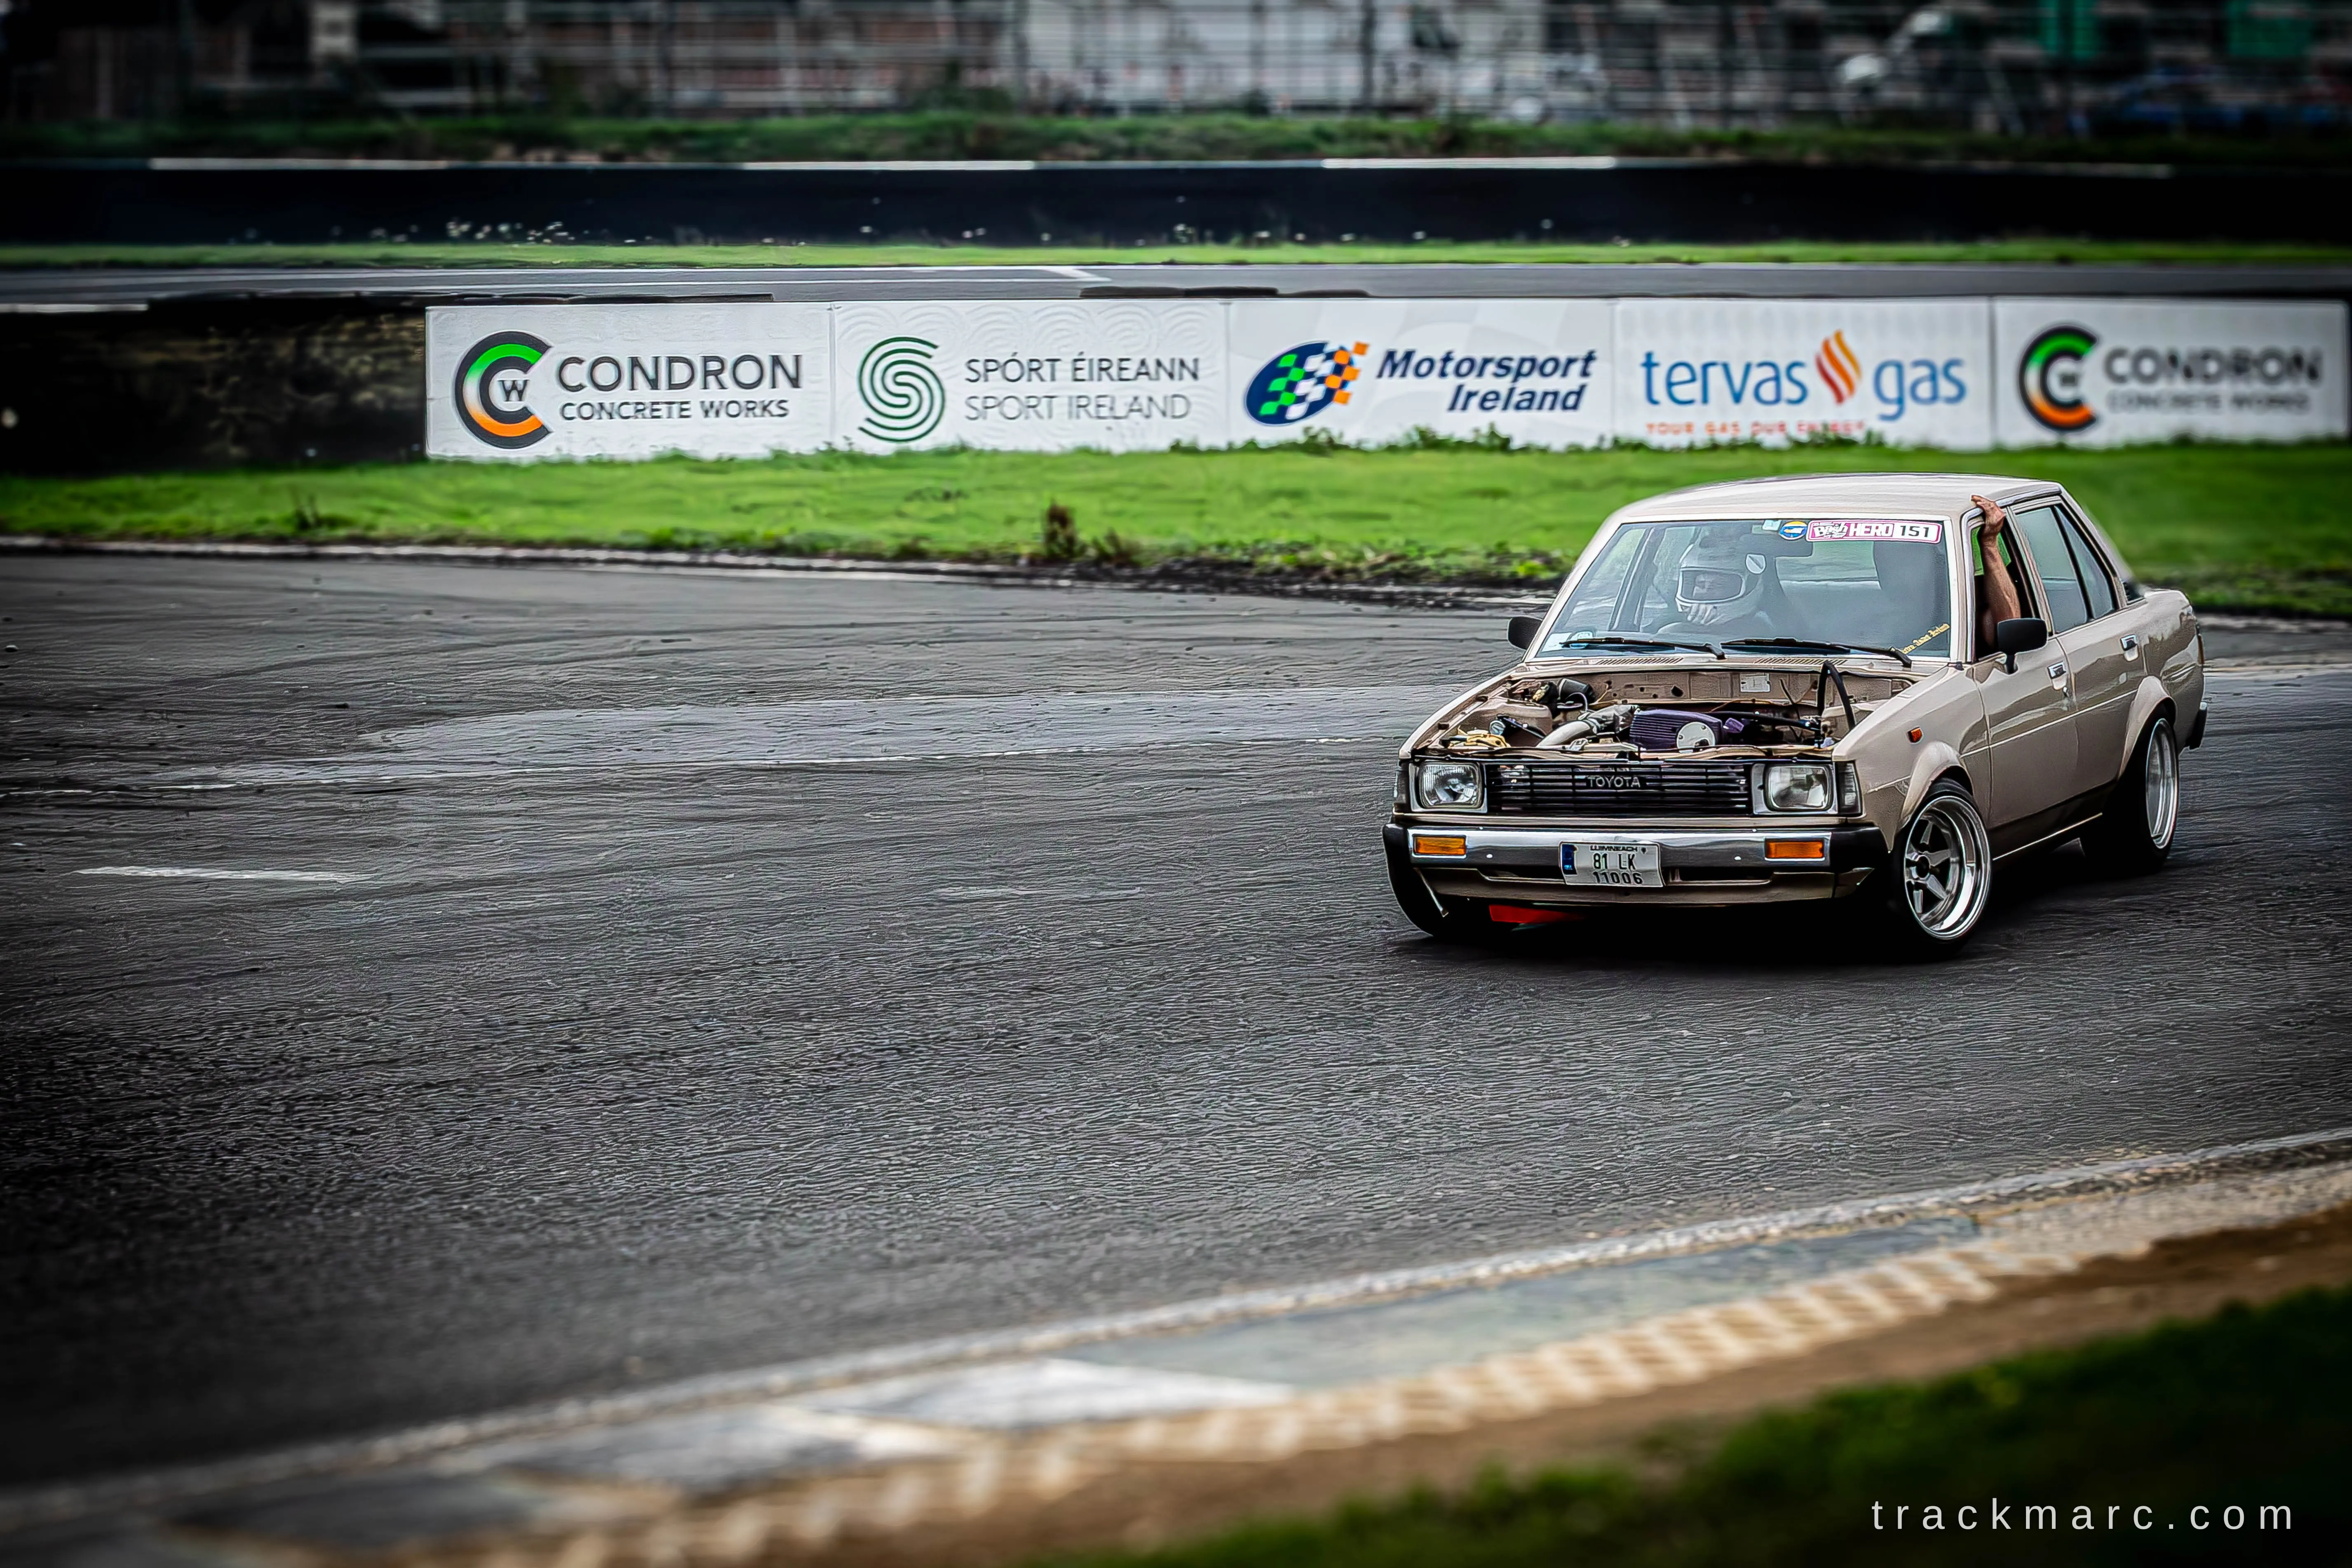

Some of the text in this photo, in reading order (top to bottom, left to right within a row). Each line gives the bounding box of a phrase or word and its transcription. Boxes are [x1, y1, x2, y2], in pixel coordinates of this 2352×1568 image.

[556, 354, 803, 392] CONDRON
[965, 351, 1199, 383] SPÓRT ÉIREANN
[1376, 350, 1597, 383] Motorsport
[1447, 383, 1587, 412] Ireland
[1641, 350, 1968, 422] tervas gas
[560, 399, 789, 420] CONCRETE WORKS
[965, 394, 1191, 420] SPORT IRELAND
[1646, 421, 1694, 435] YOUR
[1704, 421, 1740, 435] GAS
[1848, 523, 1894, 537] HERO
[1900, 525, 1930, 538] 151
[1587, 775, 1641, 788] TOYOTA
[1593, 853, 1636, 870] 81 LK
[1592, 871, 1643, 885] 11006
